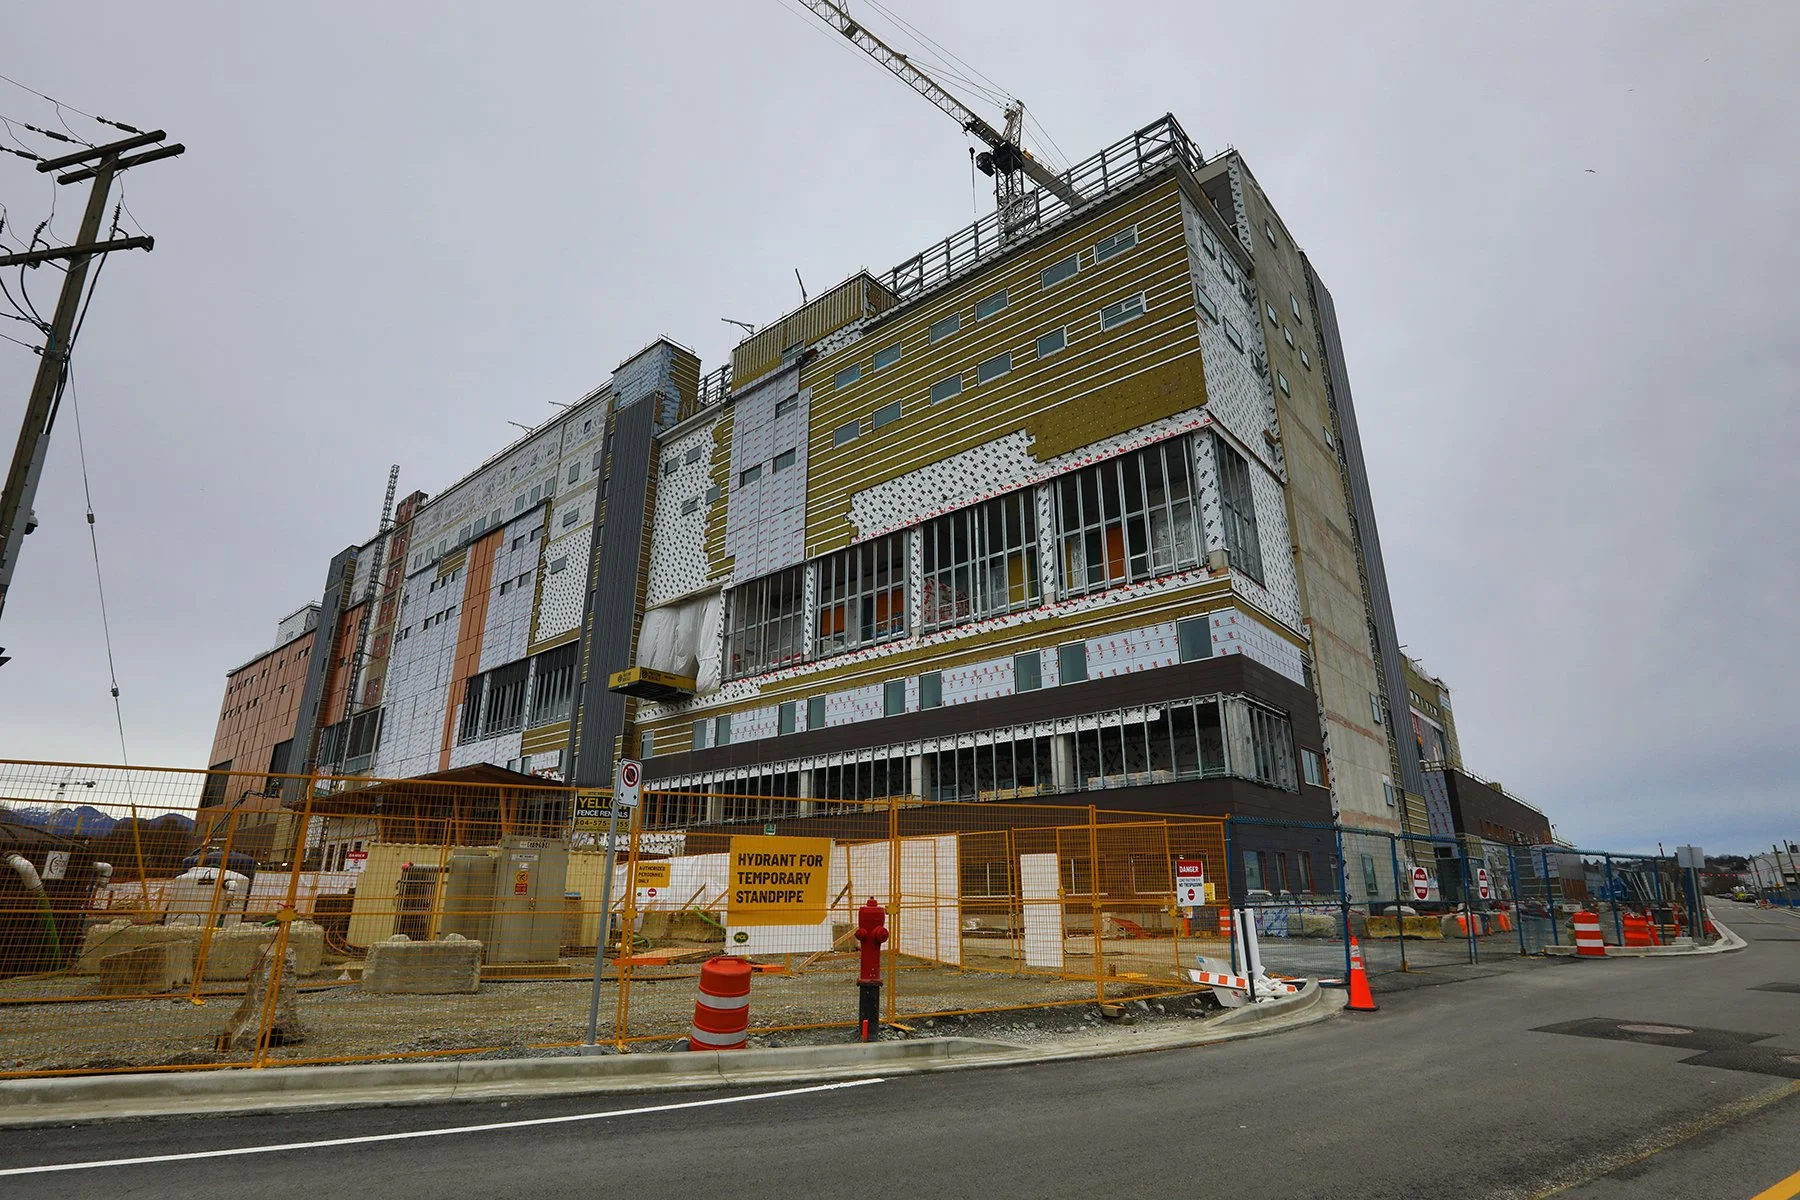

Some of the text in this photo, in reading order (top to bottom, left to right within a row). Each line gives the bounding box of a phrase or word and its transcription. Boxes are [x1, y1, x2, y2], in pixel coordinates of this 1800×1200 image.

[579, 797, 627, 810] YELL
[738, 853, 824, 868] HYDRANT FOR
[737, 871, 812, 885] TEMPORARY
[736, 890, 805, 904] STANDPIPE
